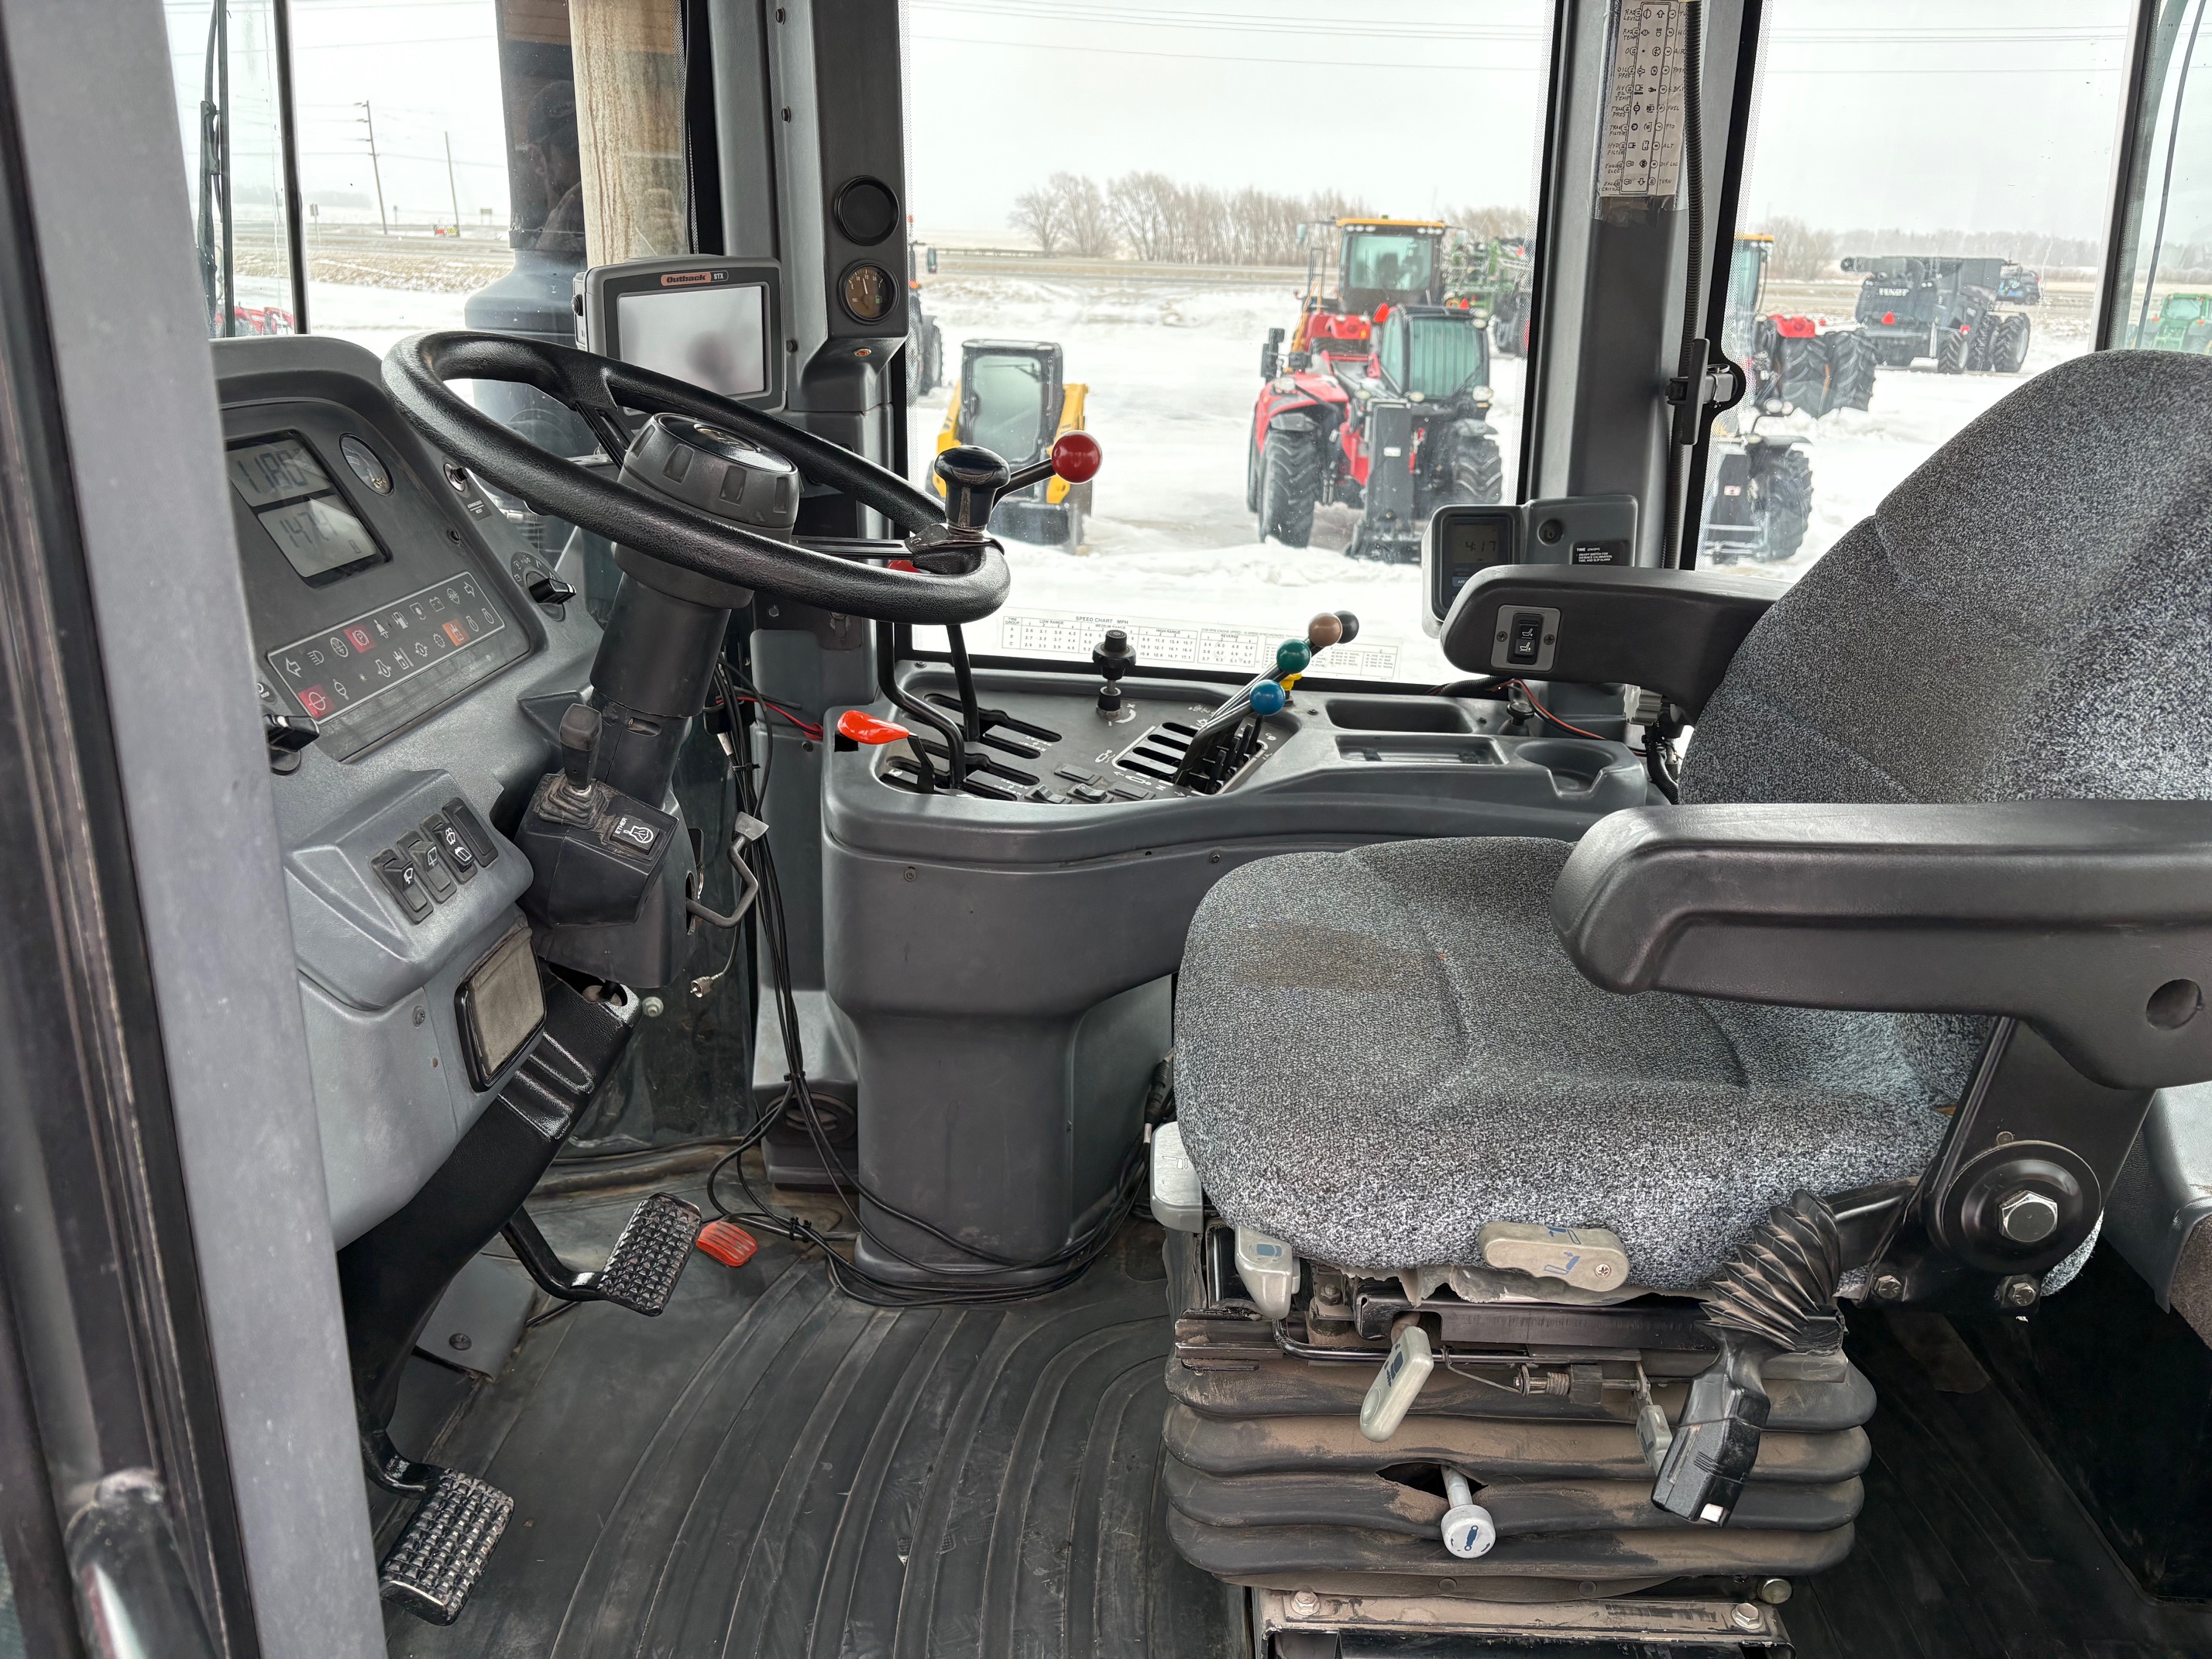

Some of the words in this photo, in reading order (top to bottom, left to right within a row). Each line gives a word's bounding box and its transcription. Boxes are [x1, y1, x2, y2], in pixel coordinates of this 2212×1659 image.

[666, 275, 706, 283] Outback
[1465, 541, 1496, 551] 4:17
[614, 817, 628, 834] ETHER
